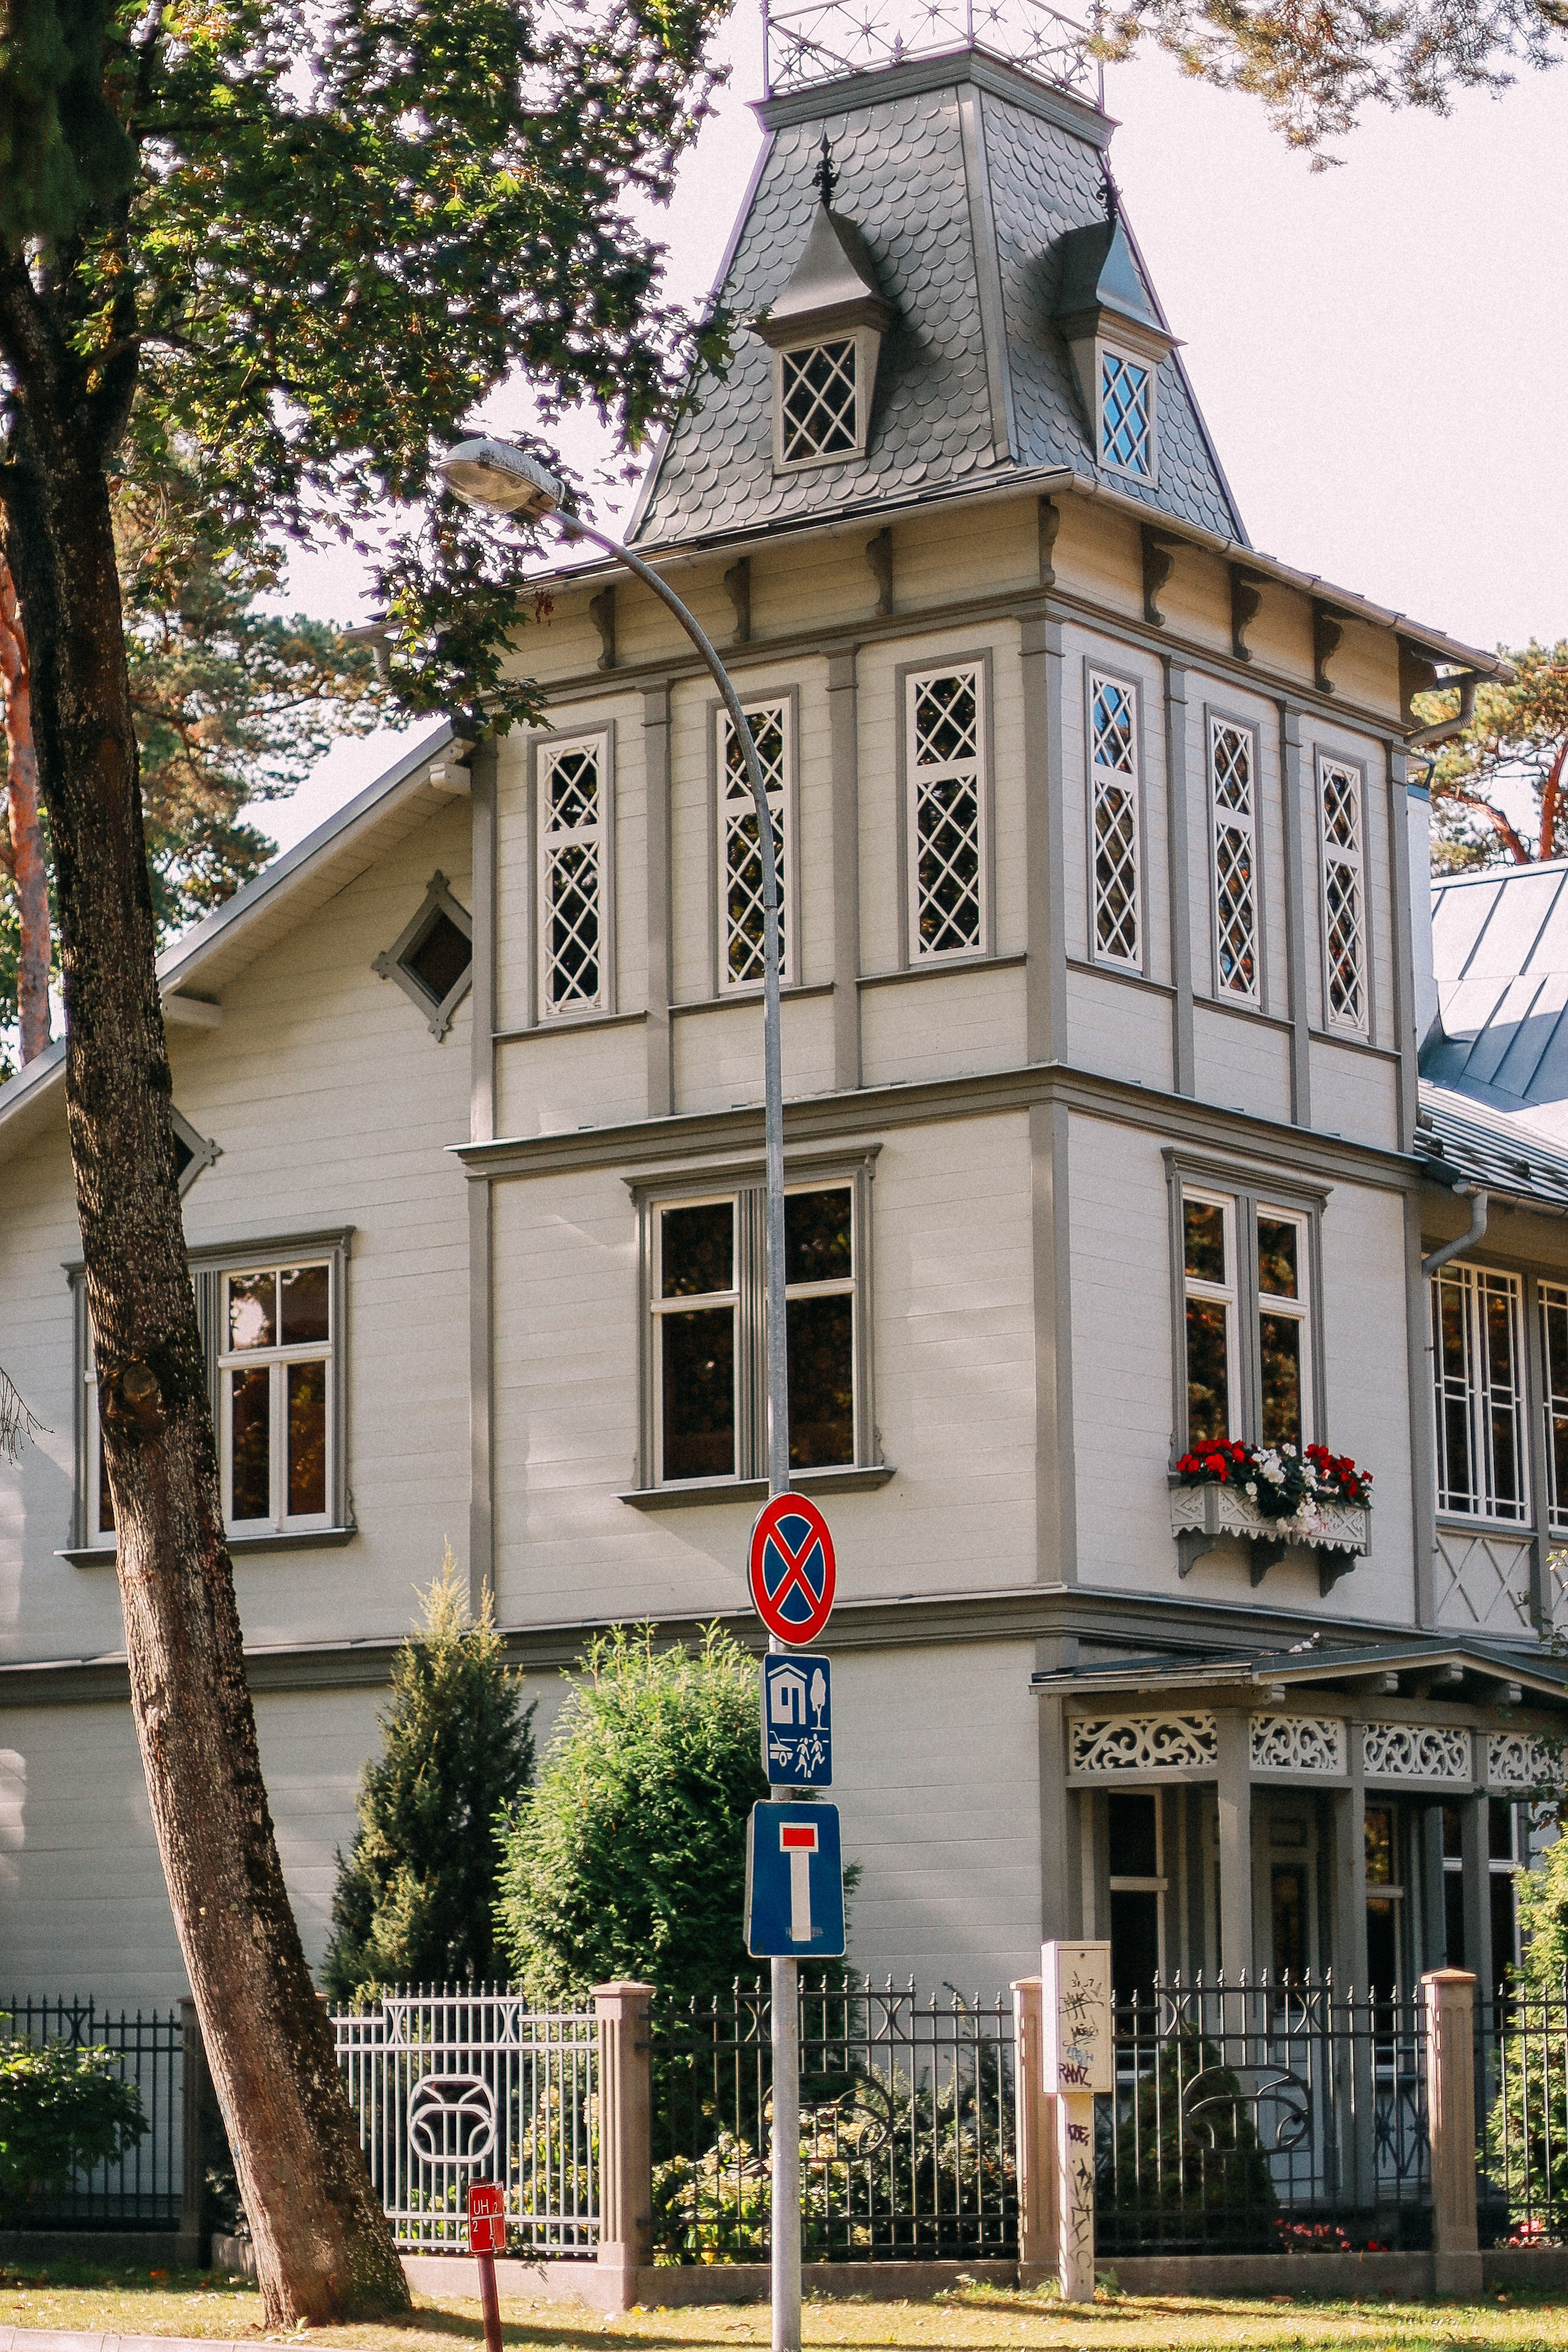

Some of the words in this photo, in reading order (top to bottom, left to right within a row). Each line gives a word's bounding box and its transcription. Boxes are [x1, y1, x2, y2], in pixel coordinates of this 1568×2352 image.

[473, 2199, 489, 2215] UH
[494, 2202, 498, 2213] 2
[472, 2221, 478, 2233] 2
